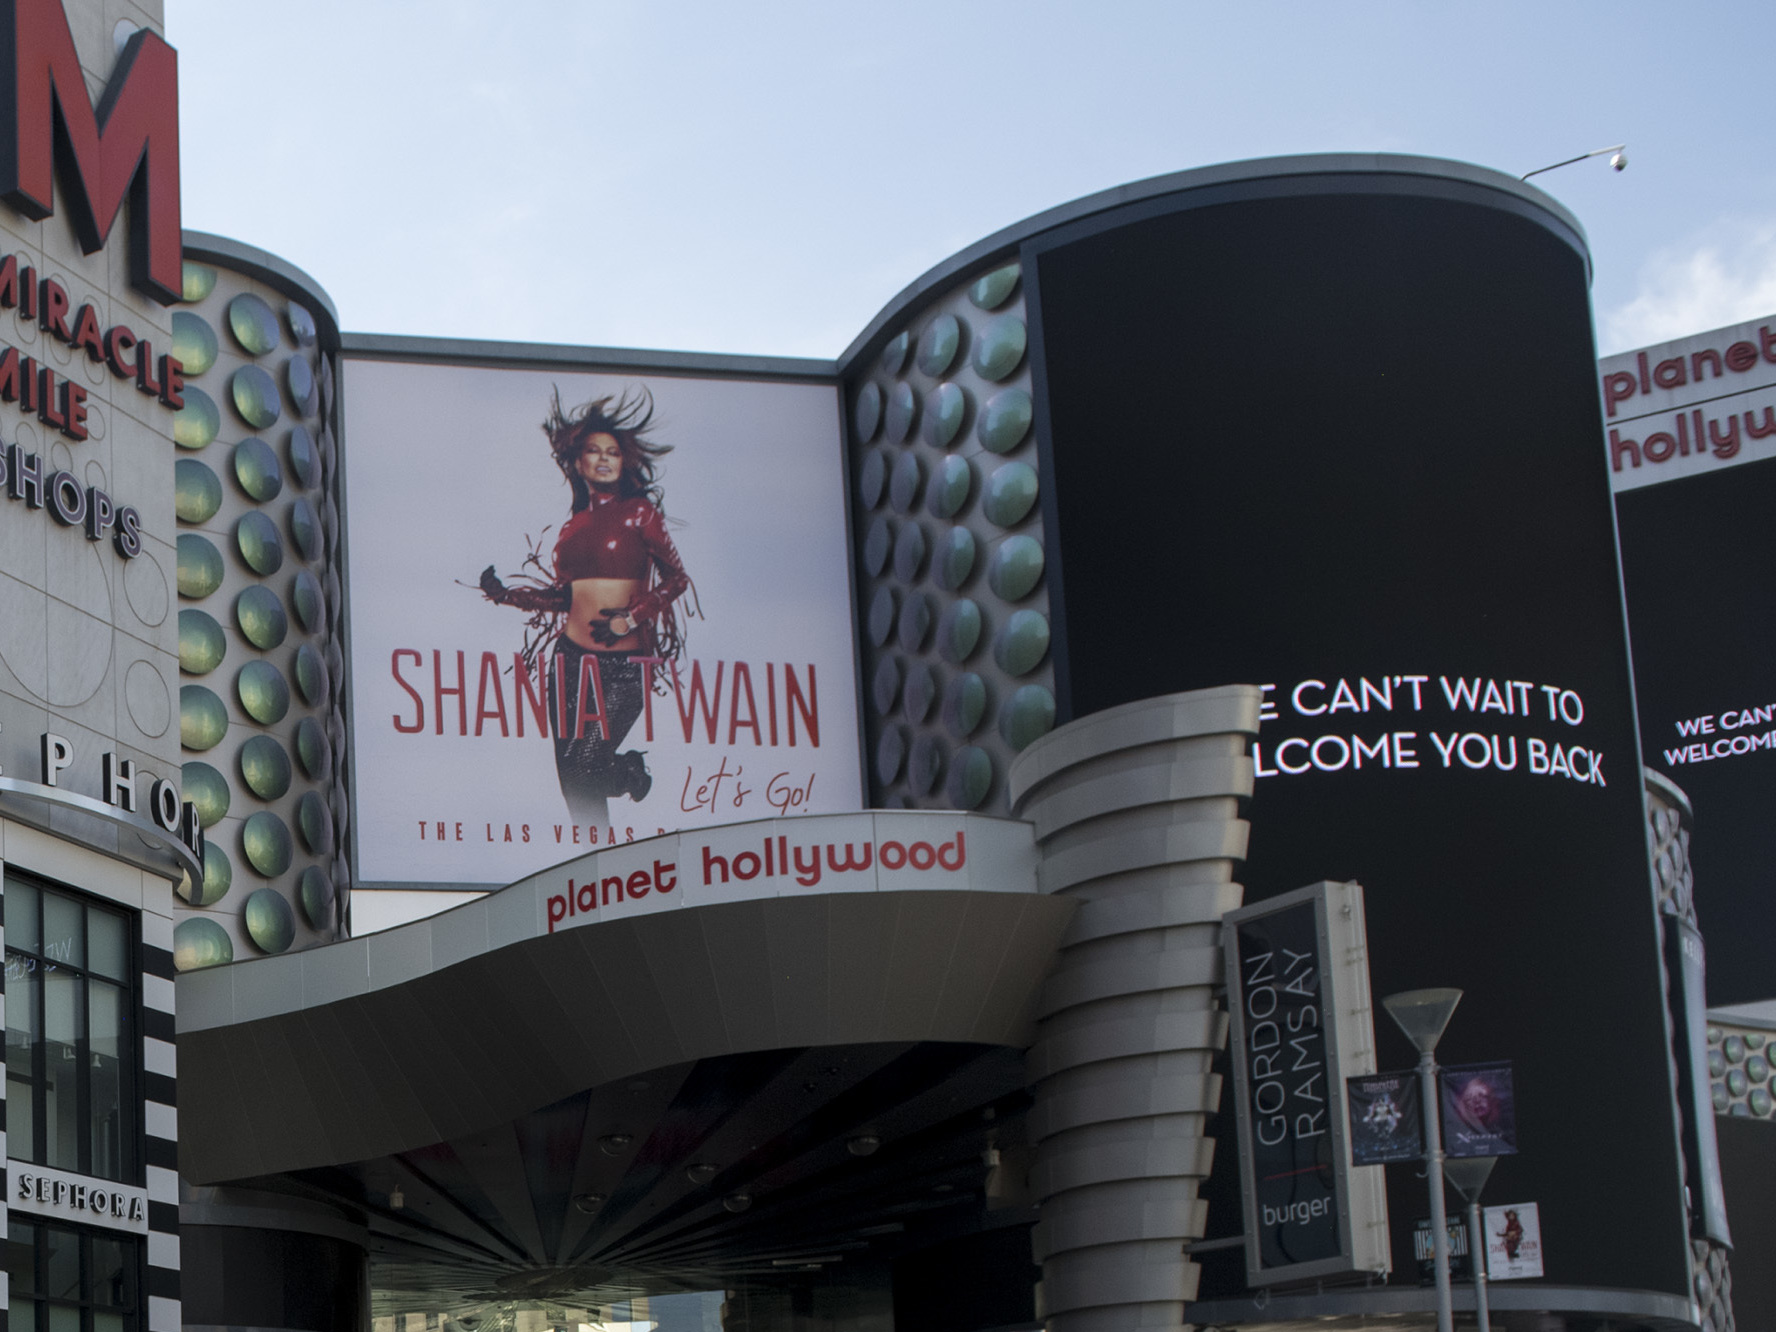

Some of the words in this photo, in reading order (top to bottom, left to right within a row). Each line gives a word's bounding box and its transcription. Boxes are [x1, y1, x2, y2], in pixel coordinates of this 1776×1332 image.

[1609, 406, 1776, 473] hollyw
[391, 648, 611, 741] SHANIA
[627, 656, 821, 748] TWAIN
[1292, 675, 1428, 716] CAN'T
[1439, 676, 1534, 717] WAIT
[1541, 685, 1584, 726] TO
[1675, 714, 1716, 738] WE
[1719, 703, 1776, 730] CAN'
[679, 756, 751, 814] Let's
[766, 773, 816, 815] Go!
[1252, 731, 1420, 777] LCOME
[1429, 731, 1518, 771] YOU
[1527, 738, 1607, 787] BACK
[418, 821, 463, 842] THE
[487, 823, 531, 844] LAS
[554, 825, 634, 845] VEGAS
[546, 859, 677, 934] planet
[702, 831, 965, 887] hollywood
[1246, 952, 1287, 1145] GORDON
[1283, 949, 1325, 1139] RAMSAY
[19, 1173, 145, 1222] SEPHORA
[1264, 1196, 1331, 1226] burger
